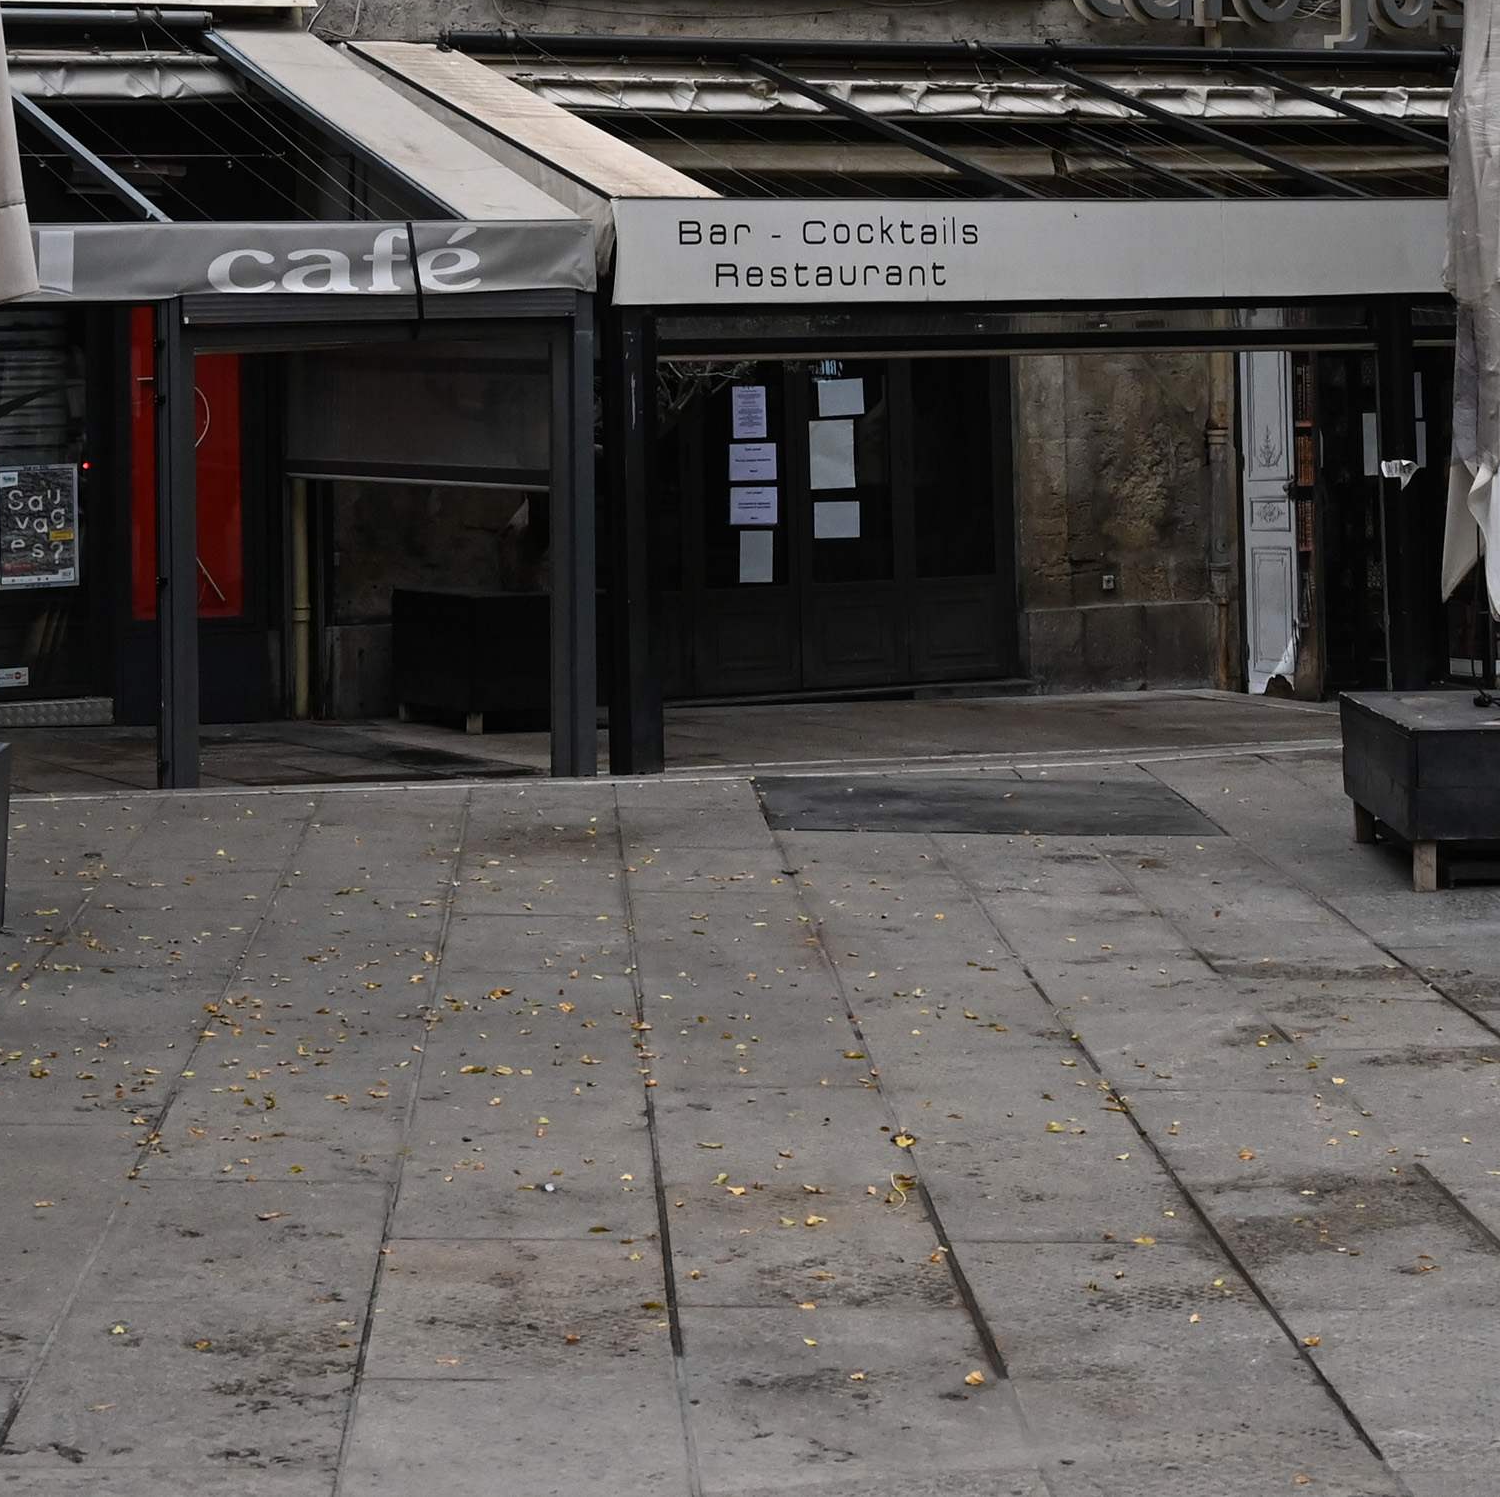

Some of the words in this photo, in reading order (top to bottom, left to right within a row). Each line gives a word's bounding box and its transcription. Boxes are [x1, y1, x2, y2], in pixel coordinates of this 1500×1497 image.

[678, 219, 751, 245] Bar
[802, 215, 979, 245] Cocktails
[207, 226, 481, 293] café
[715, 262, 947, 287] Restaurant
